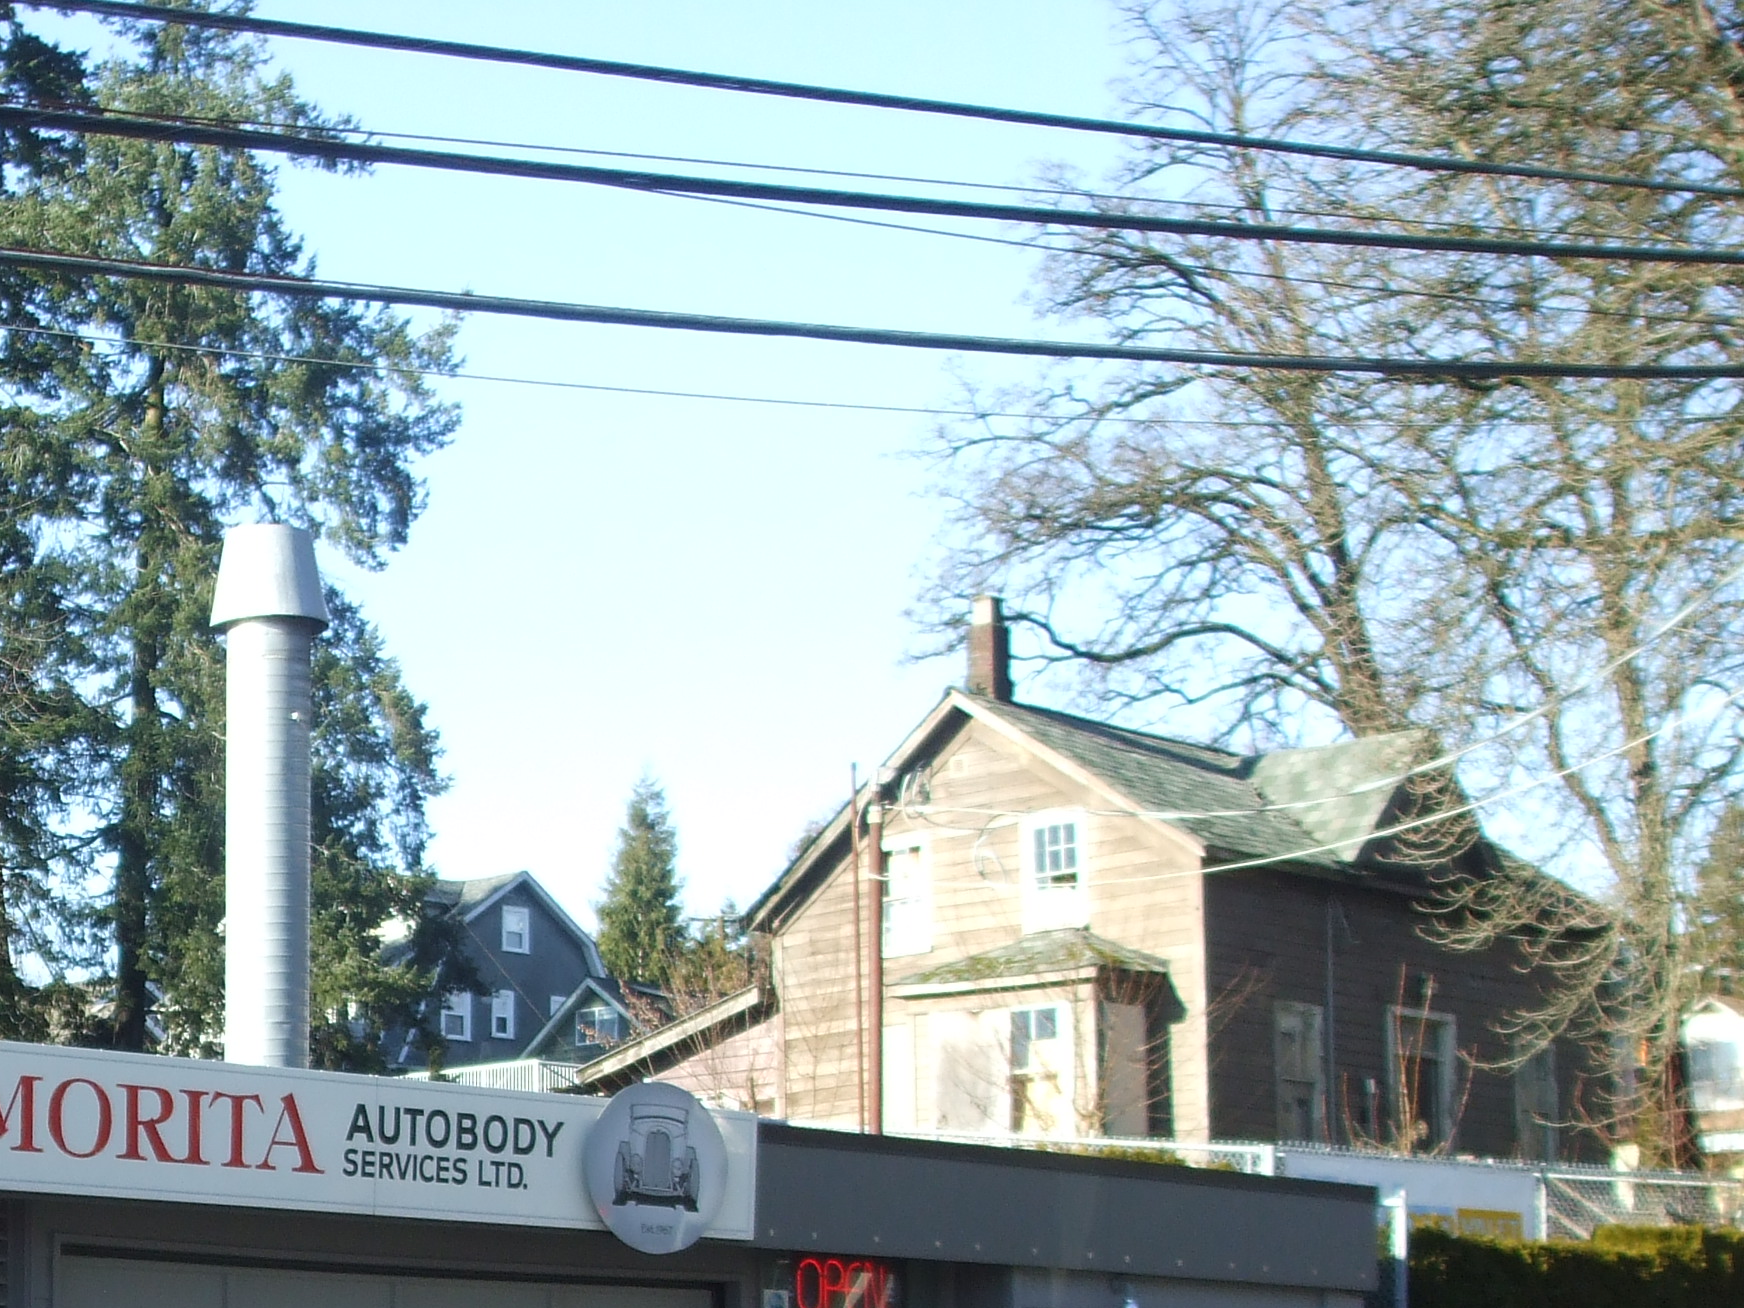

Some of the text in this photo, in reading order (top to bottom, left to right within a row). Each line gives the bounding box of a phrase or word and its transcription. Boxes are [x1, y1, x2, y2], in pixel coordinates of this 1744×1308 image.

[346, 1102, 566, 1159] AUTOBODY
[342, 1148, 529, 1191] SERVICES LTD.
